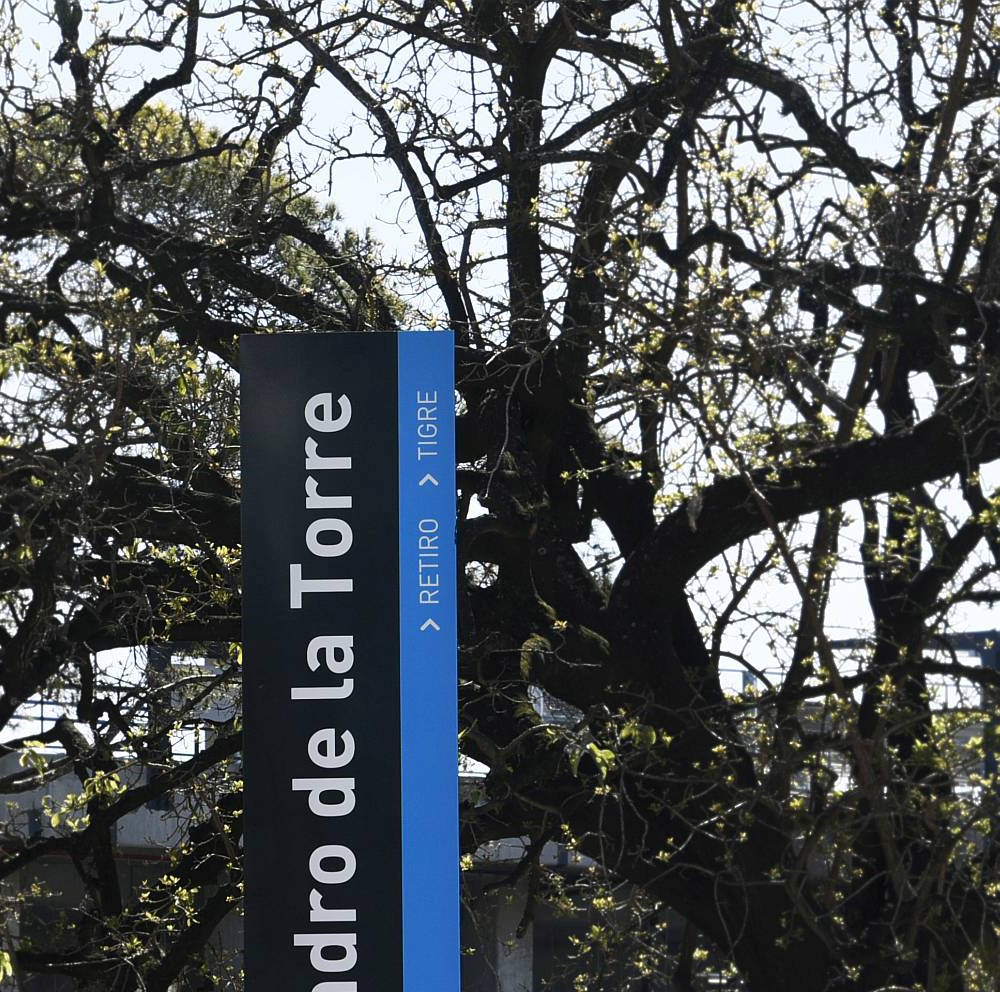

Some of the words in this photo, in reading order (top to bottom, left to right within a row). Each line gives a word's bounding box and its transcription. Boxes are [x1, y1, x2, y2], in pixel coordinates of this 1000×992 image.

[417, 391, 438, 461] TIGRE
[290, 393, 354, 609] Torre
[418, 519, 439, 604] RETIRO
[290, 636, 355, 700] la
[291, 729, 356, 817] de
